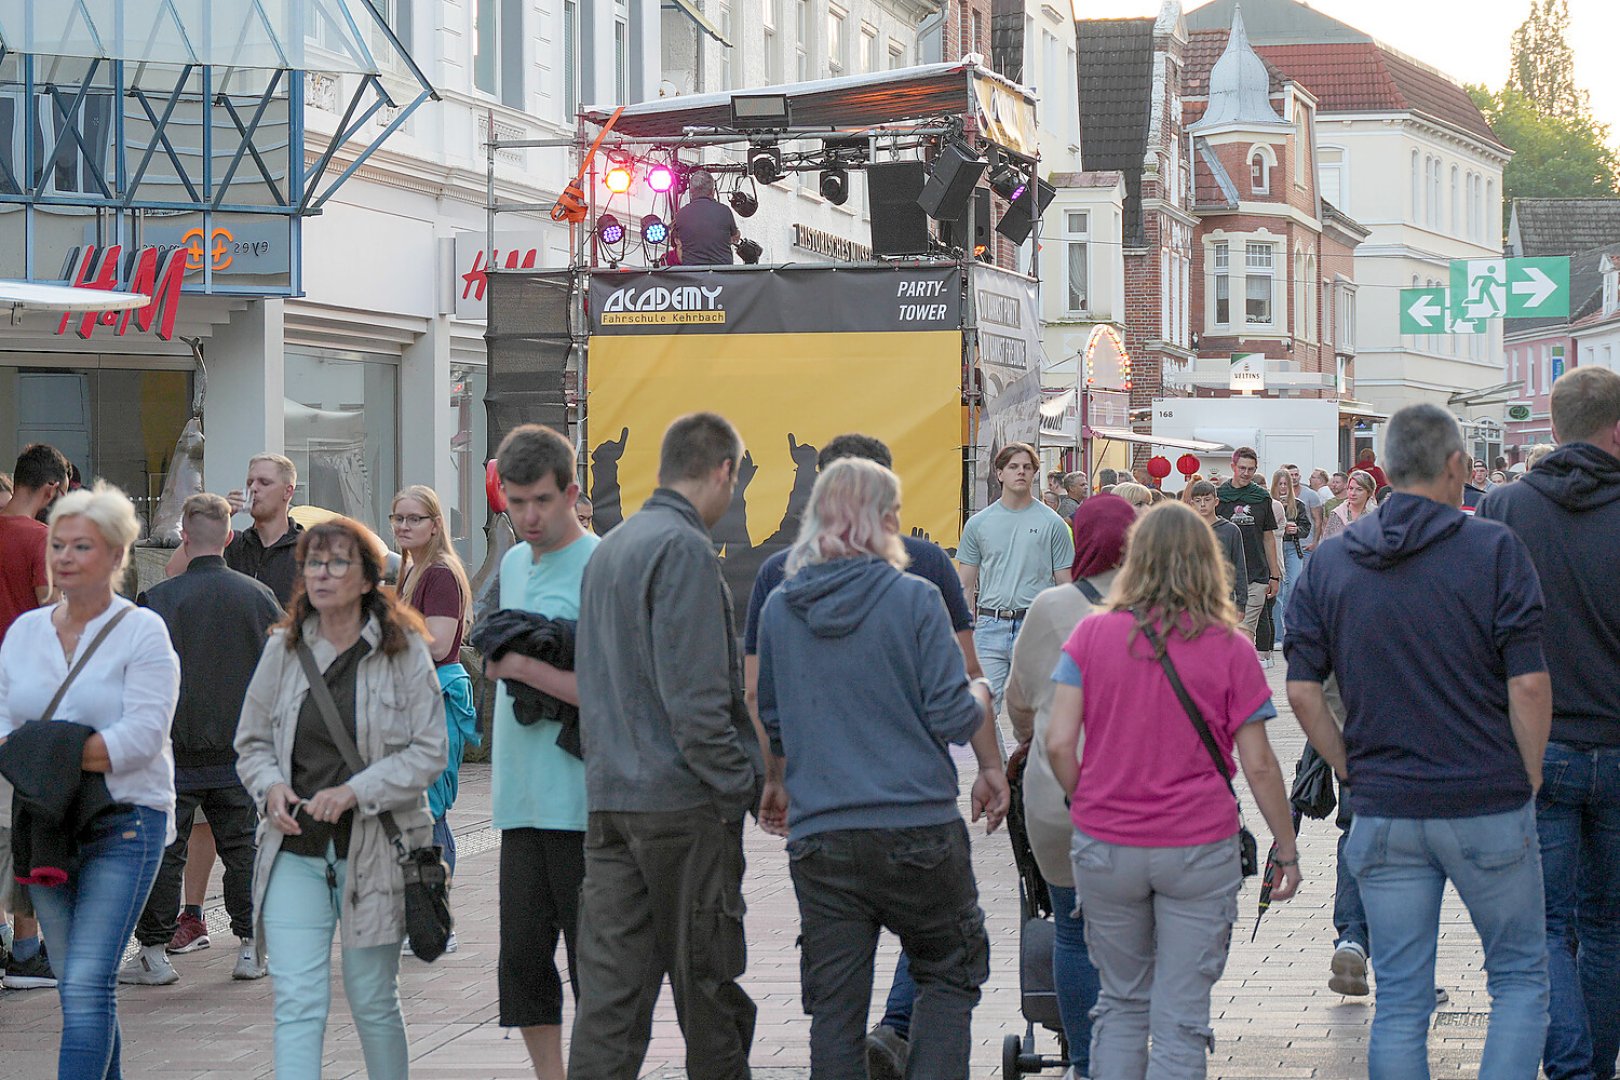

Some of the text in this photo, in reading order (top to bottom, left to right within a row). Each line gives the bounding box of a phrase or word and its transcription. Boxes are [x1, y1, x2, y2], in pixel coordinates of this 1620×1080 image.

[897, 281, 947, 297] PARTY-
[603, 312, 724, 324] Fahrschule Kehrbach
[898, 304, 947, 321] TOWER
[1233, 372, 1260, 380] VELTINS
[1159, 410, 1174, 418] 168
